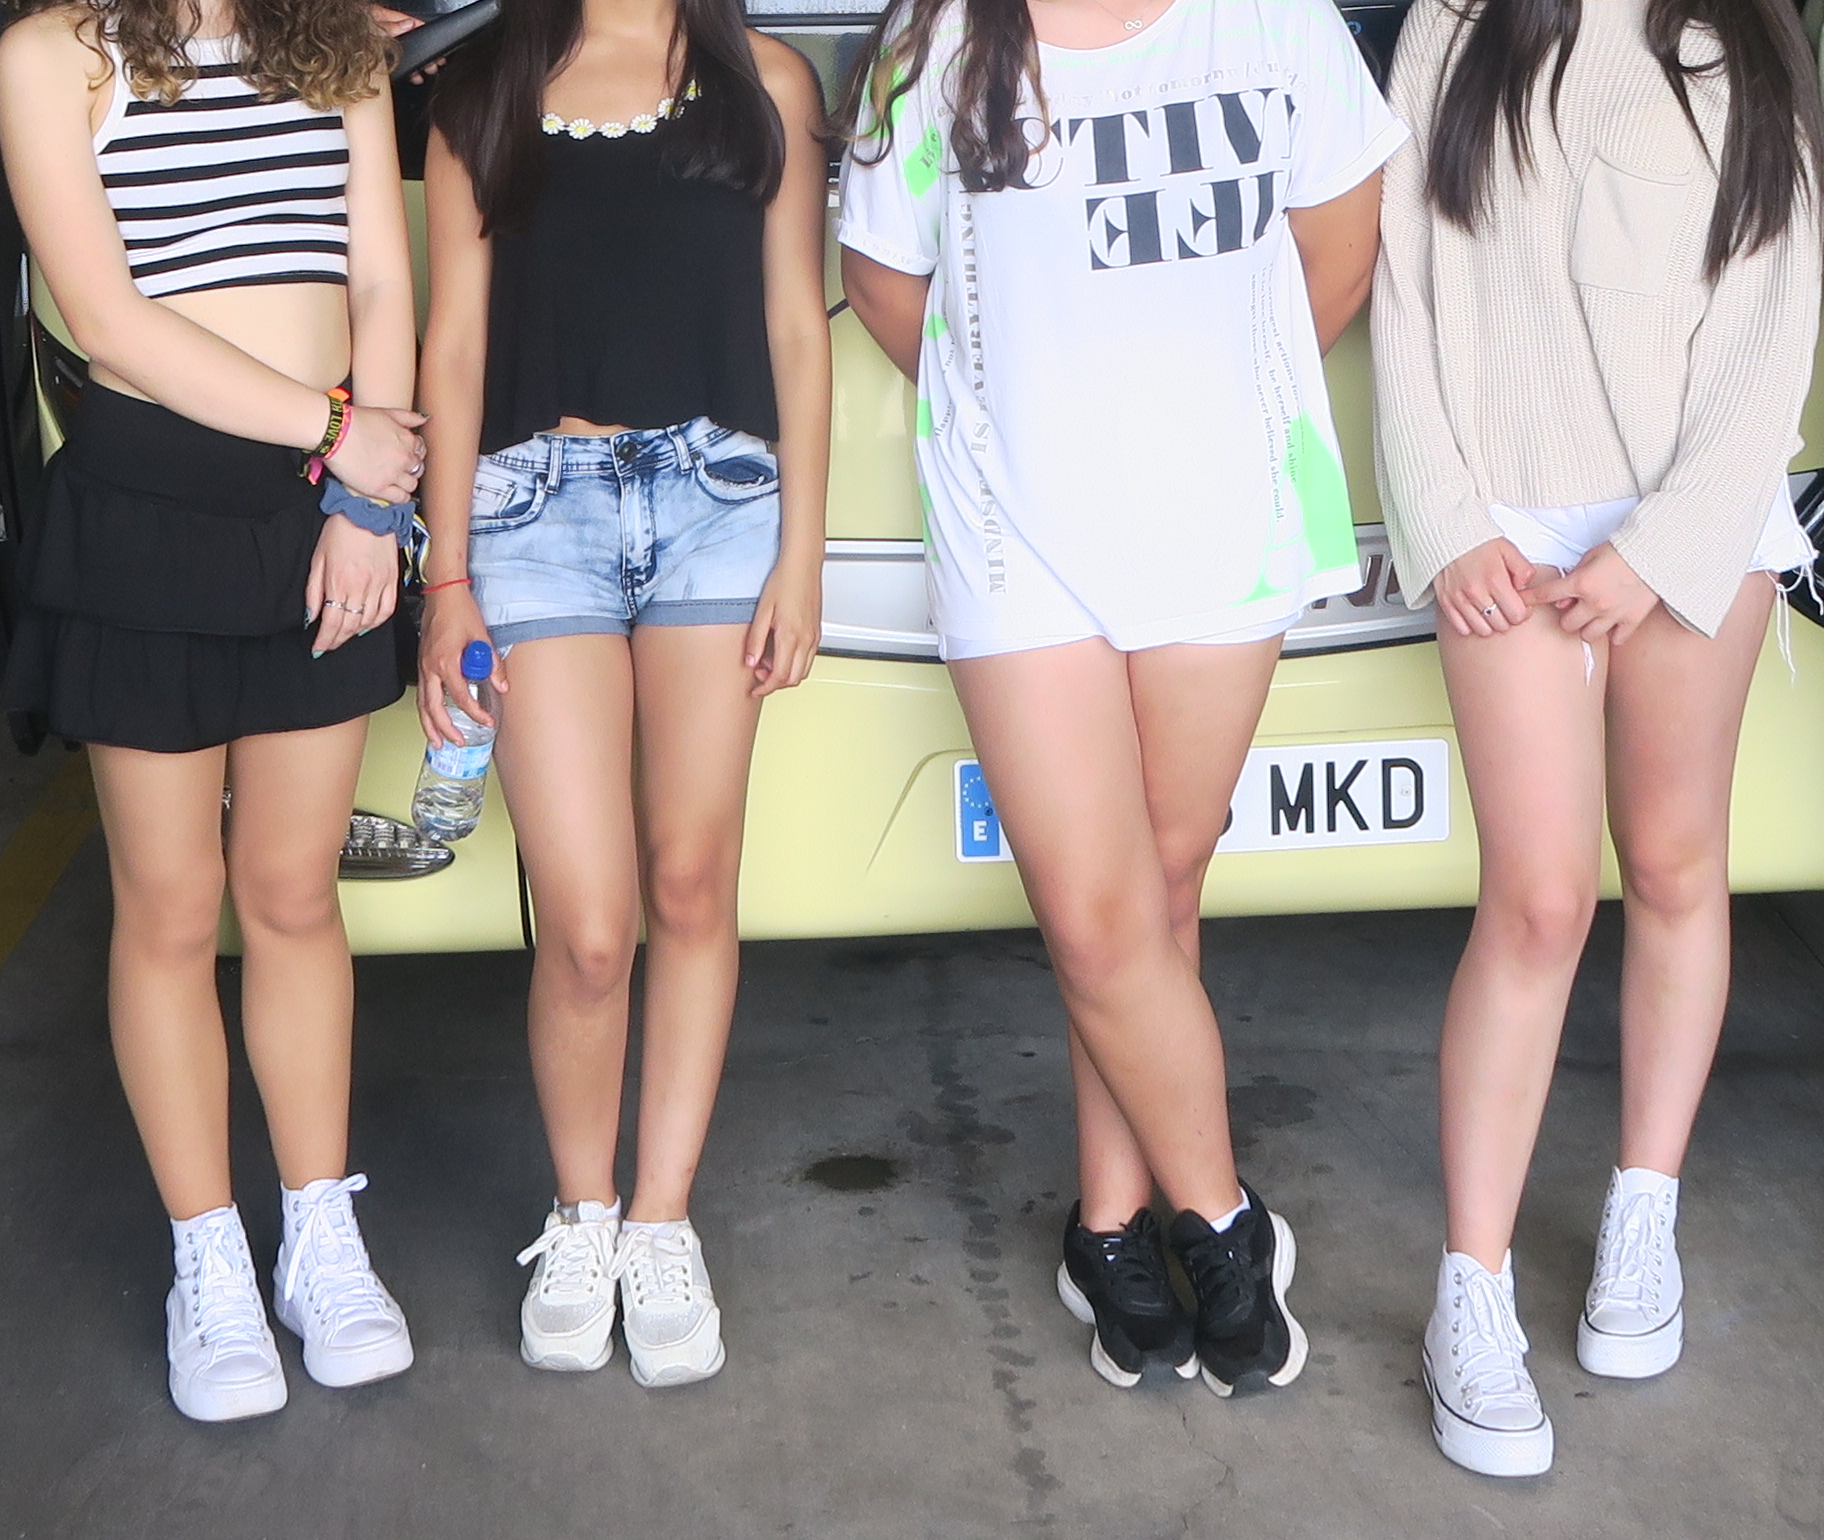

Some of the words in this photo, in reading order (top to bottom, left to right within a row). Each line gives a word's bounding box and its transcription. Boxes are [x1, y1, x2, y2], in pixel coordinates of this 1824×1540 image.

[1256, 383, 1269, 415] never
[1274, 384, 1292, 425] herself
[970, 421, 991, 454] IS
[1264, 415, 1278, 463] believed
[1283, 428, 1295, 449] and
[1270, 465, 1280, 486] she
[1288, 452, 1299, 484] shine
[1269, 756, 1425, 837] MKD
[973, 820, 988, 842] E
